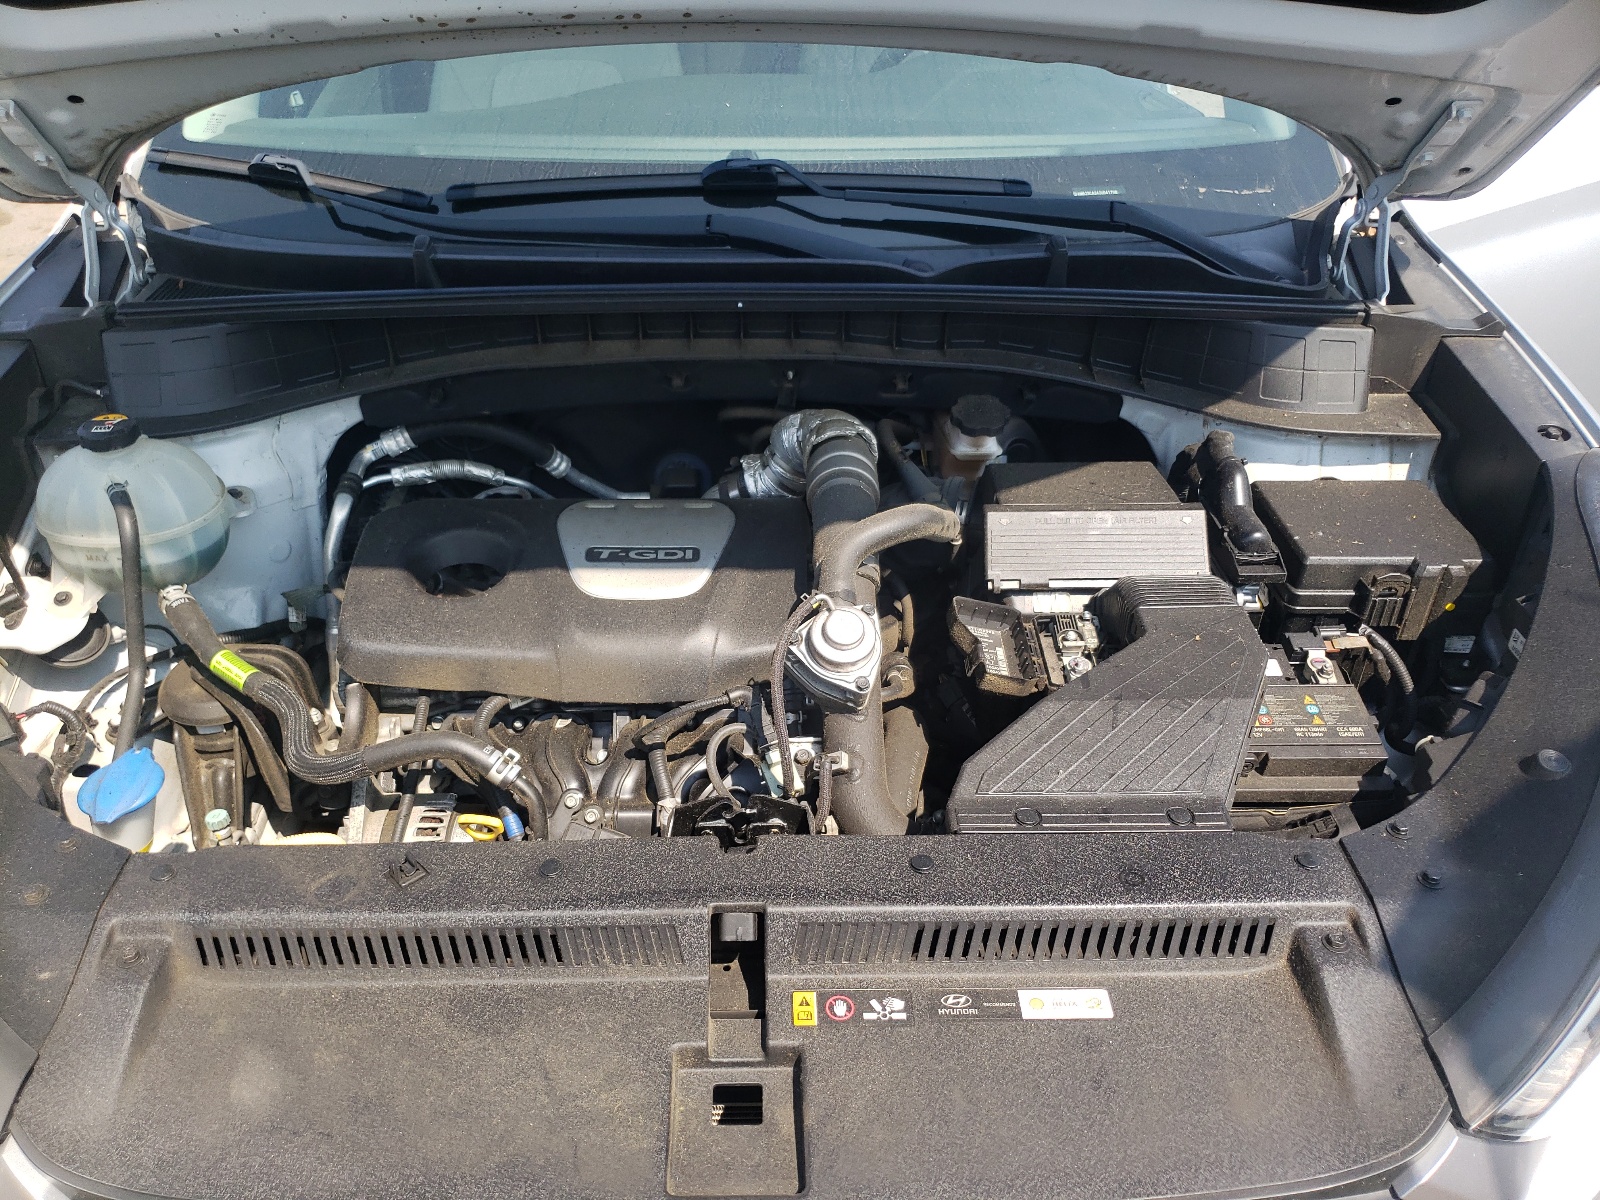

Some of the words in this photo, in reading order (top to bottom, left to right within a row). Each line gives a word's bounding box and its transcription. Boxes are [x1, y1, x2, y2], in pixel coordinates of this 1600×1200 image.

[1034, 516, 1055, 525] PULL
[1057, 516, 1072, 525] OUT
[85, 553, 108, 562] MAX
[593, 548, 693, 560] T-GDI
